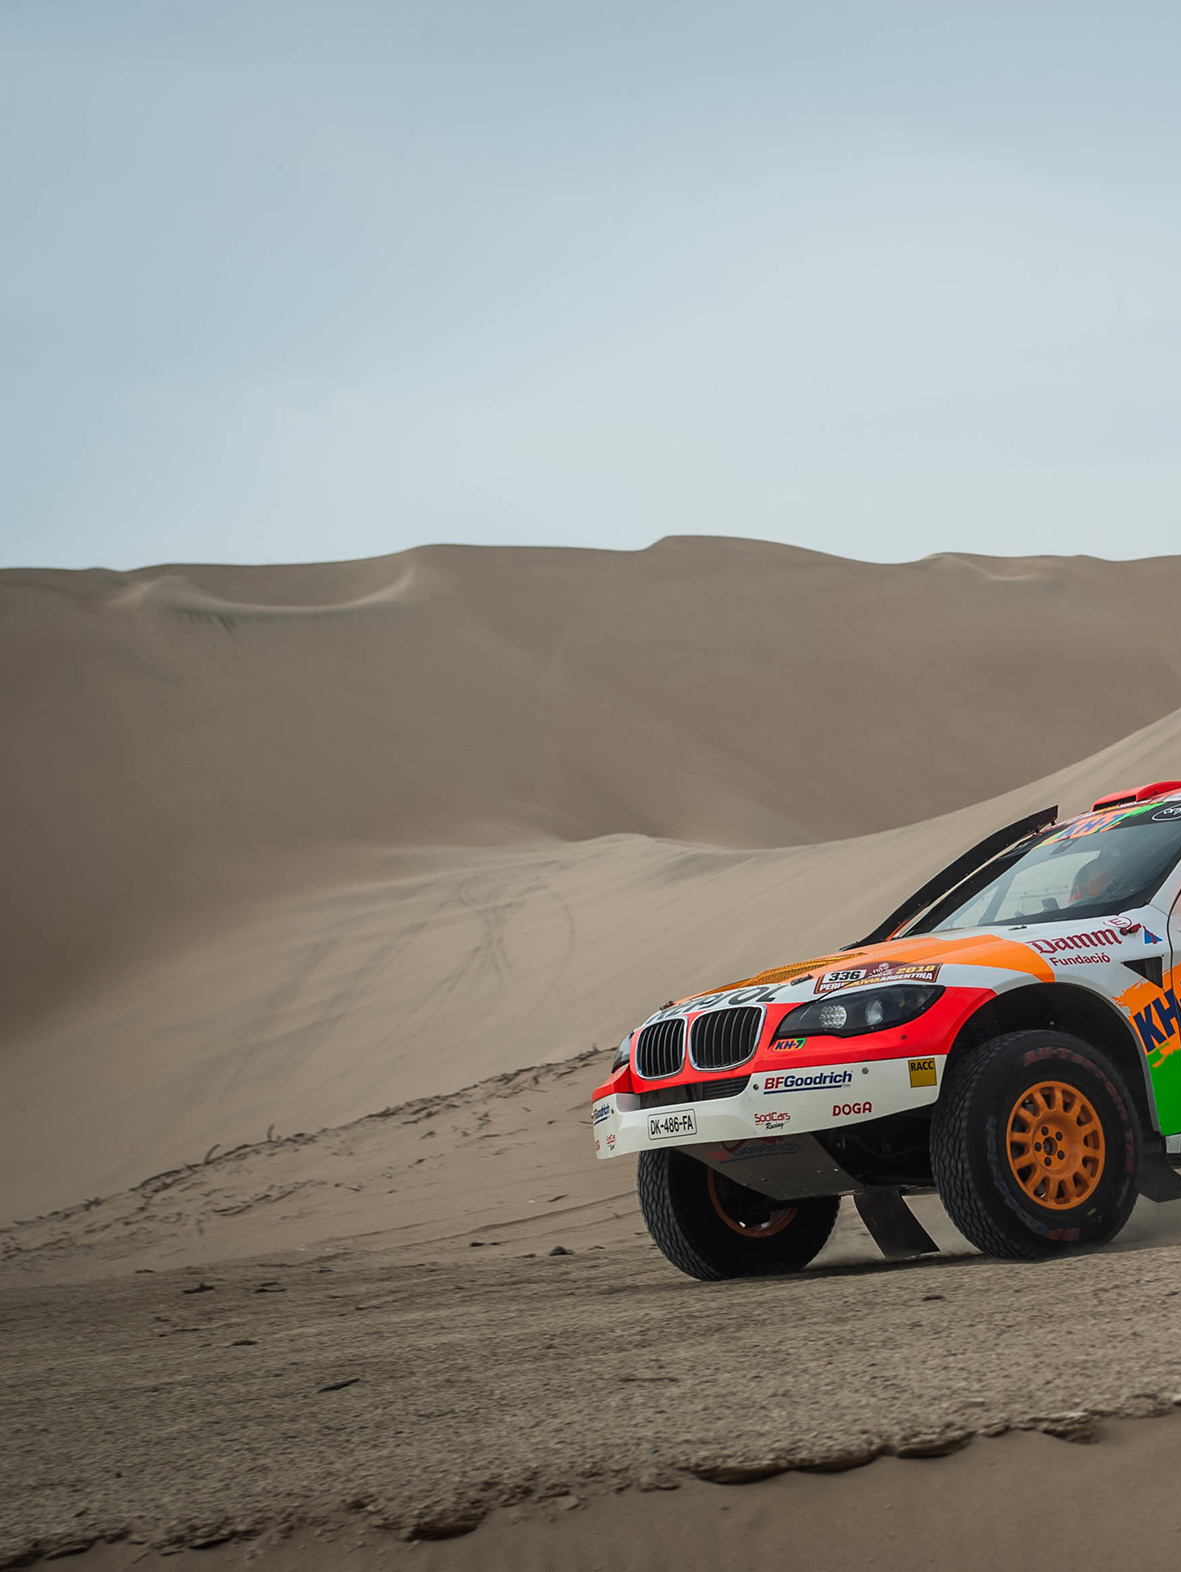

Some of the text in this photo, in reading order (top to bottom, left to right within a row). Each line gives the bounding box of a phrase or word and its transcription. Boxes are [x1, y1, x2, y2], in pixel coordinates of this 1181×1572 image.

[1024, 928, 1123, 954] Damm
[1049, 952, 1111, 967] Fundació
[828, 970, 862, 982] 336
[895, 965, 936, 974] 2018
[879, 971, 933, 983] ARGENTINA
[774, 1039, 804, 1051] KH-7
[910, 1060, 934, 1072] RACC
[764, 1070, 853, 1090] BFGoodrich
[832, 1101, 873, 1117] DOGA
[650, 1114, 694, 1136] DK-486-FA
